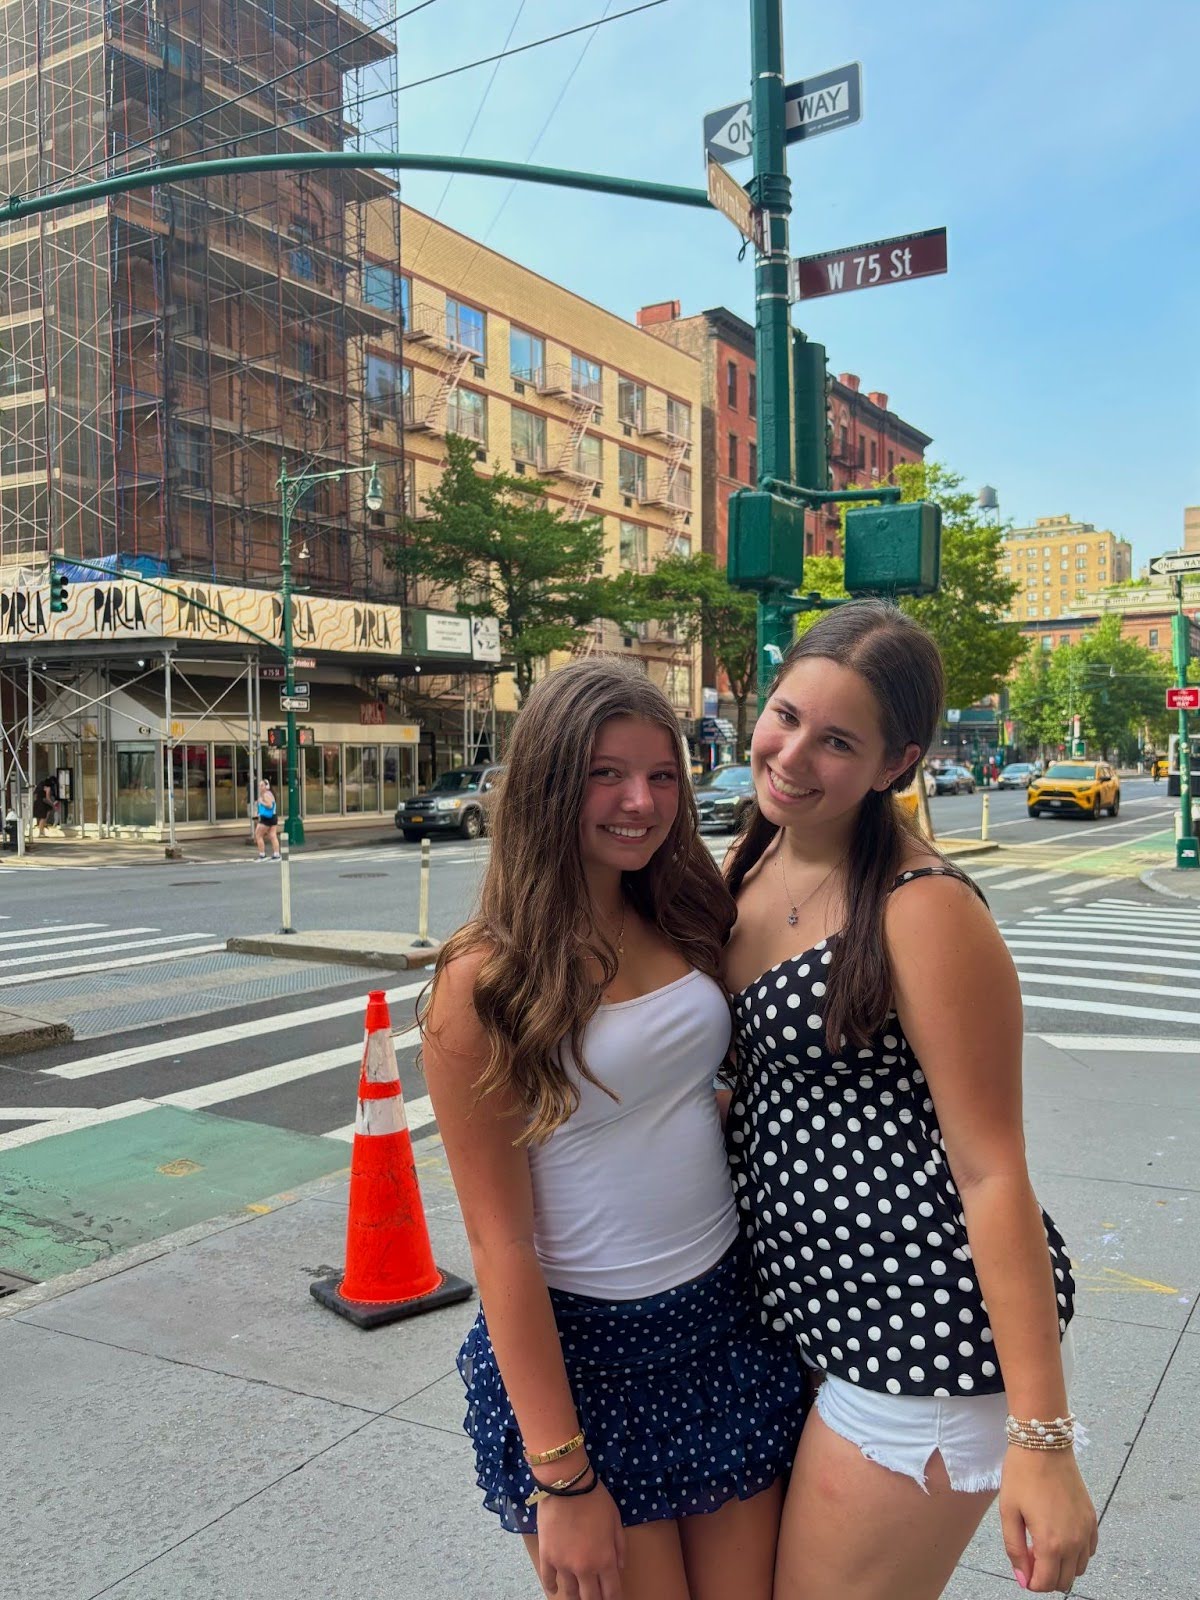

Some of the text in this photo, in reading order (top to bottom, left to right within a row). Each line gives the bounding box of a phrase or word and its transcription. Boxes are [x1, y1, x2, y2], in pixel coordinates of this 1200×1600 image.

[728, 86, 842, 144] ON WAY
[827, 261, 845, 291] W
[853, 253, 881, 285] 75
[890, 247, 912, 278] St
[1157, 562, 1175, 571] ONE
[0, 590, 47, 635] PARLA
[94, 585, 146, 632] PARLA
[177, 586, 229, 635] PARLA
[354, 607, 391, 649] PARLA
